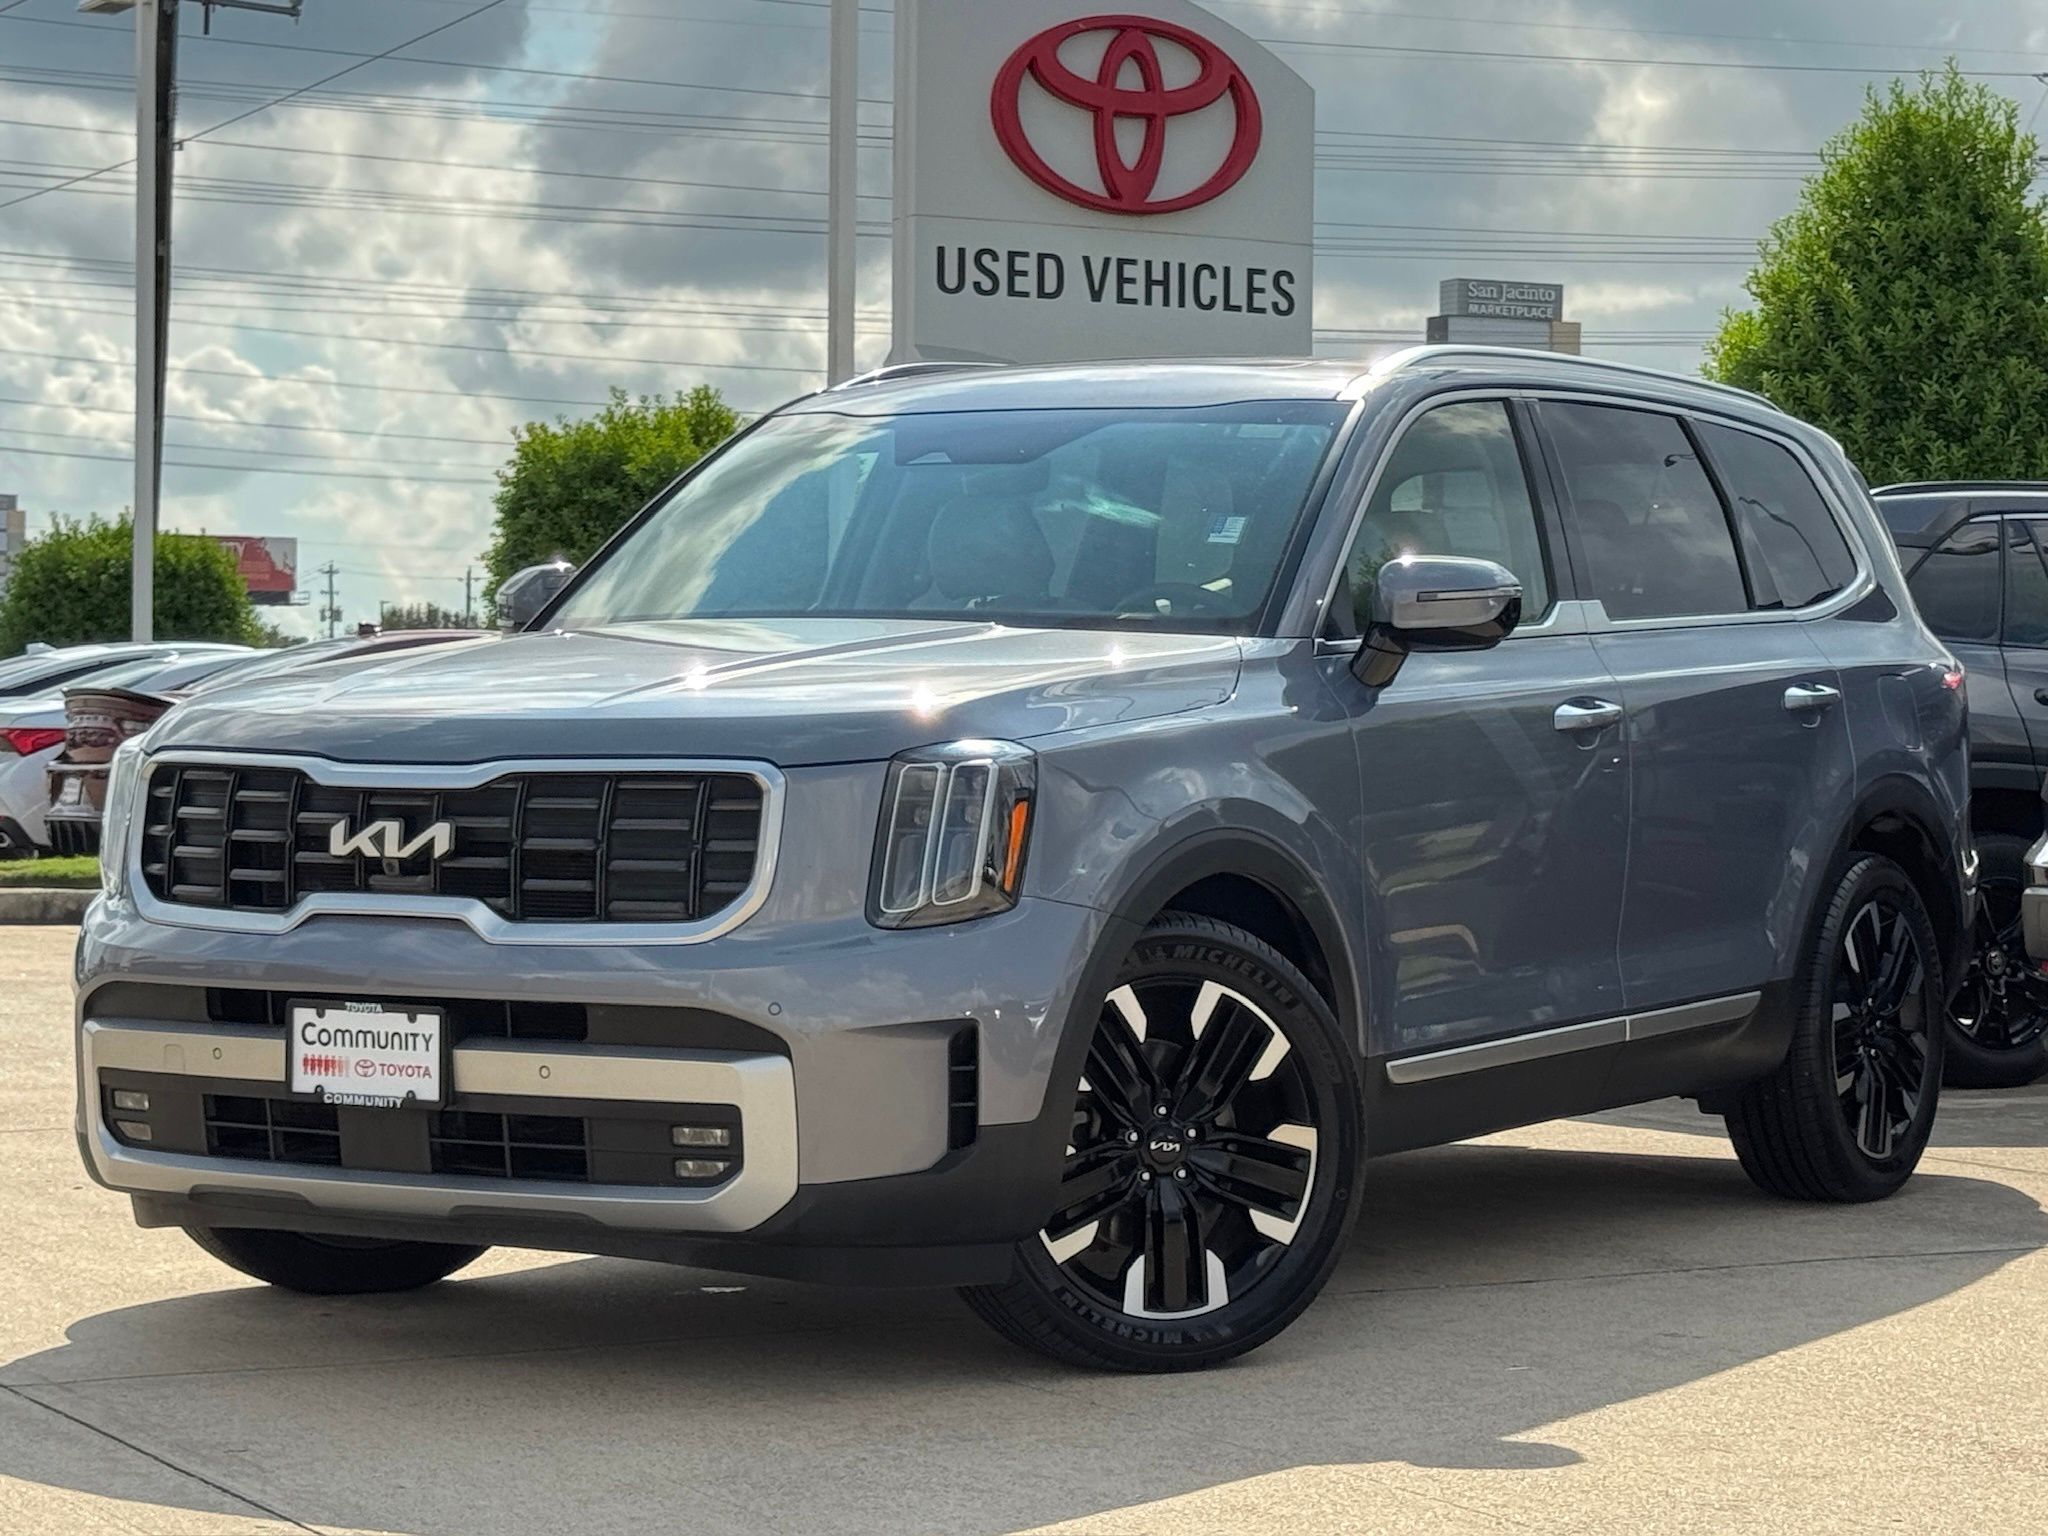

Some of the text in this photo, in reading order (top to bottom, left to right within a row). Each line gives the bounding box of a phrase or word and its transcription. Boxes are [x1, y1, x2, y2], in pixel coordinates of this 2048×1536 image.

[936, 245, 1296, 318] USED VEHICLES
[1467, 281, 1556, 303] San Jacinto
[1467, 303, 1554, 319] MARKETPLACE
[330, 819, 452, 860] KIA
[1171, 944, 1295, 1004] MICHELIN
[345, 1001, 384, 1014] TOYOTA
[379, 1062, 433, 1080] TOYOTA
[323, 1091, 404, 1109] COMMUNITY
[1059, 1290, 1183, 1345] MICHELIN
